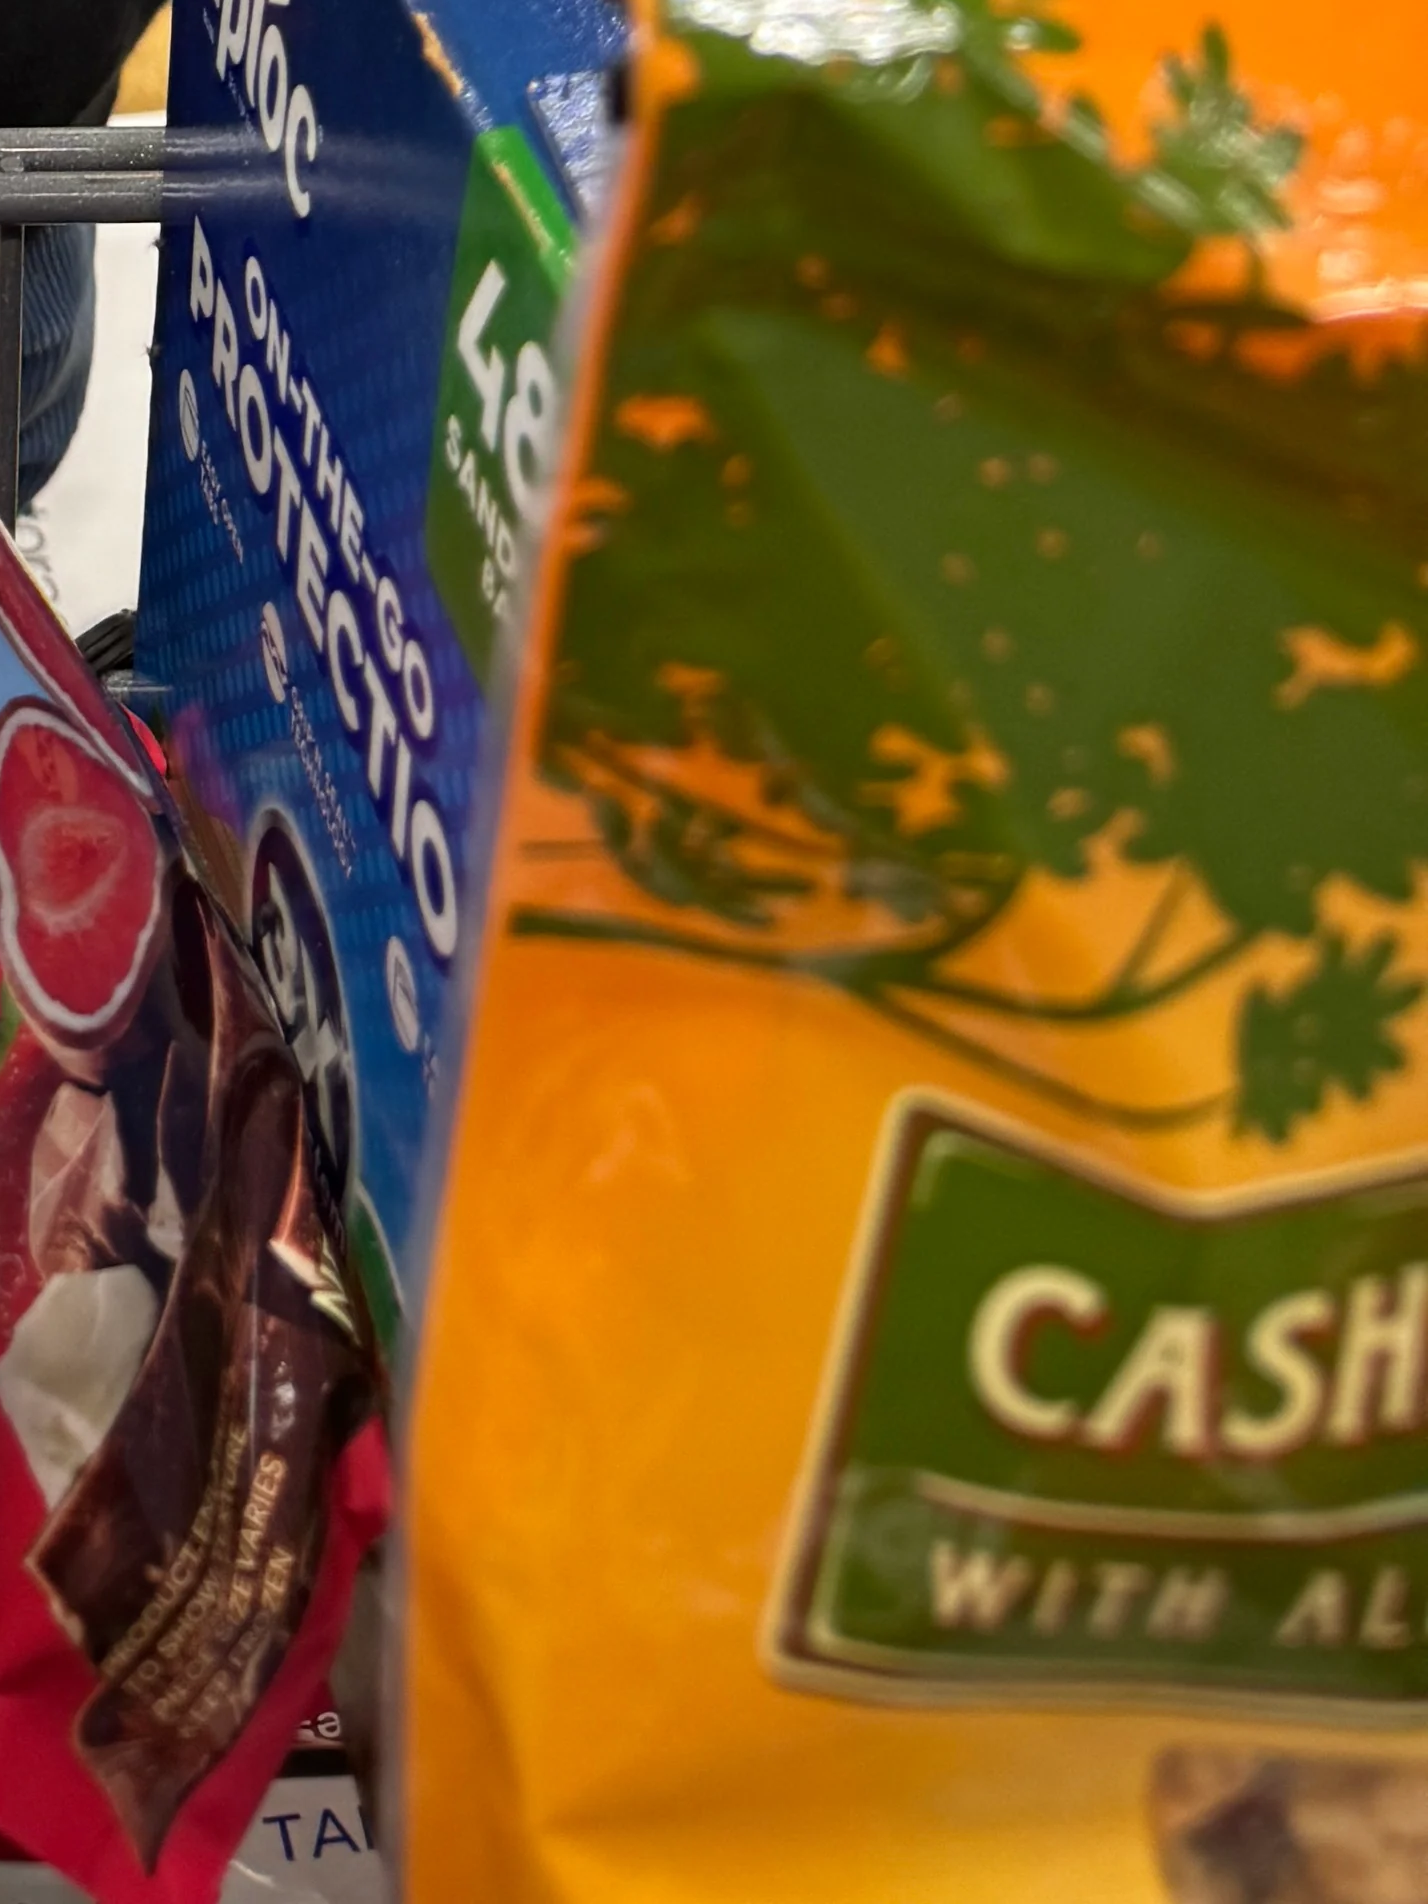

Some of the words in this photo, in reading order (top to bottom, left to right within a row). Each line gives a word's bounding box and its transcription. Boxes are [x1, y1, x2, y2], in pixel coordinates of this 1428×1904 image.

[245, 254, 436, 742] ON-THE-GO
[967, 1262, 1428, 1459] CASH
[236, 1448, 288, 1570] VARIES
[156, 1568, 222, 1659] SHOW
[929, 1540, 1228, 1641] WITH
